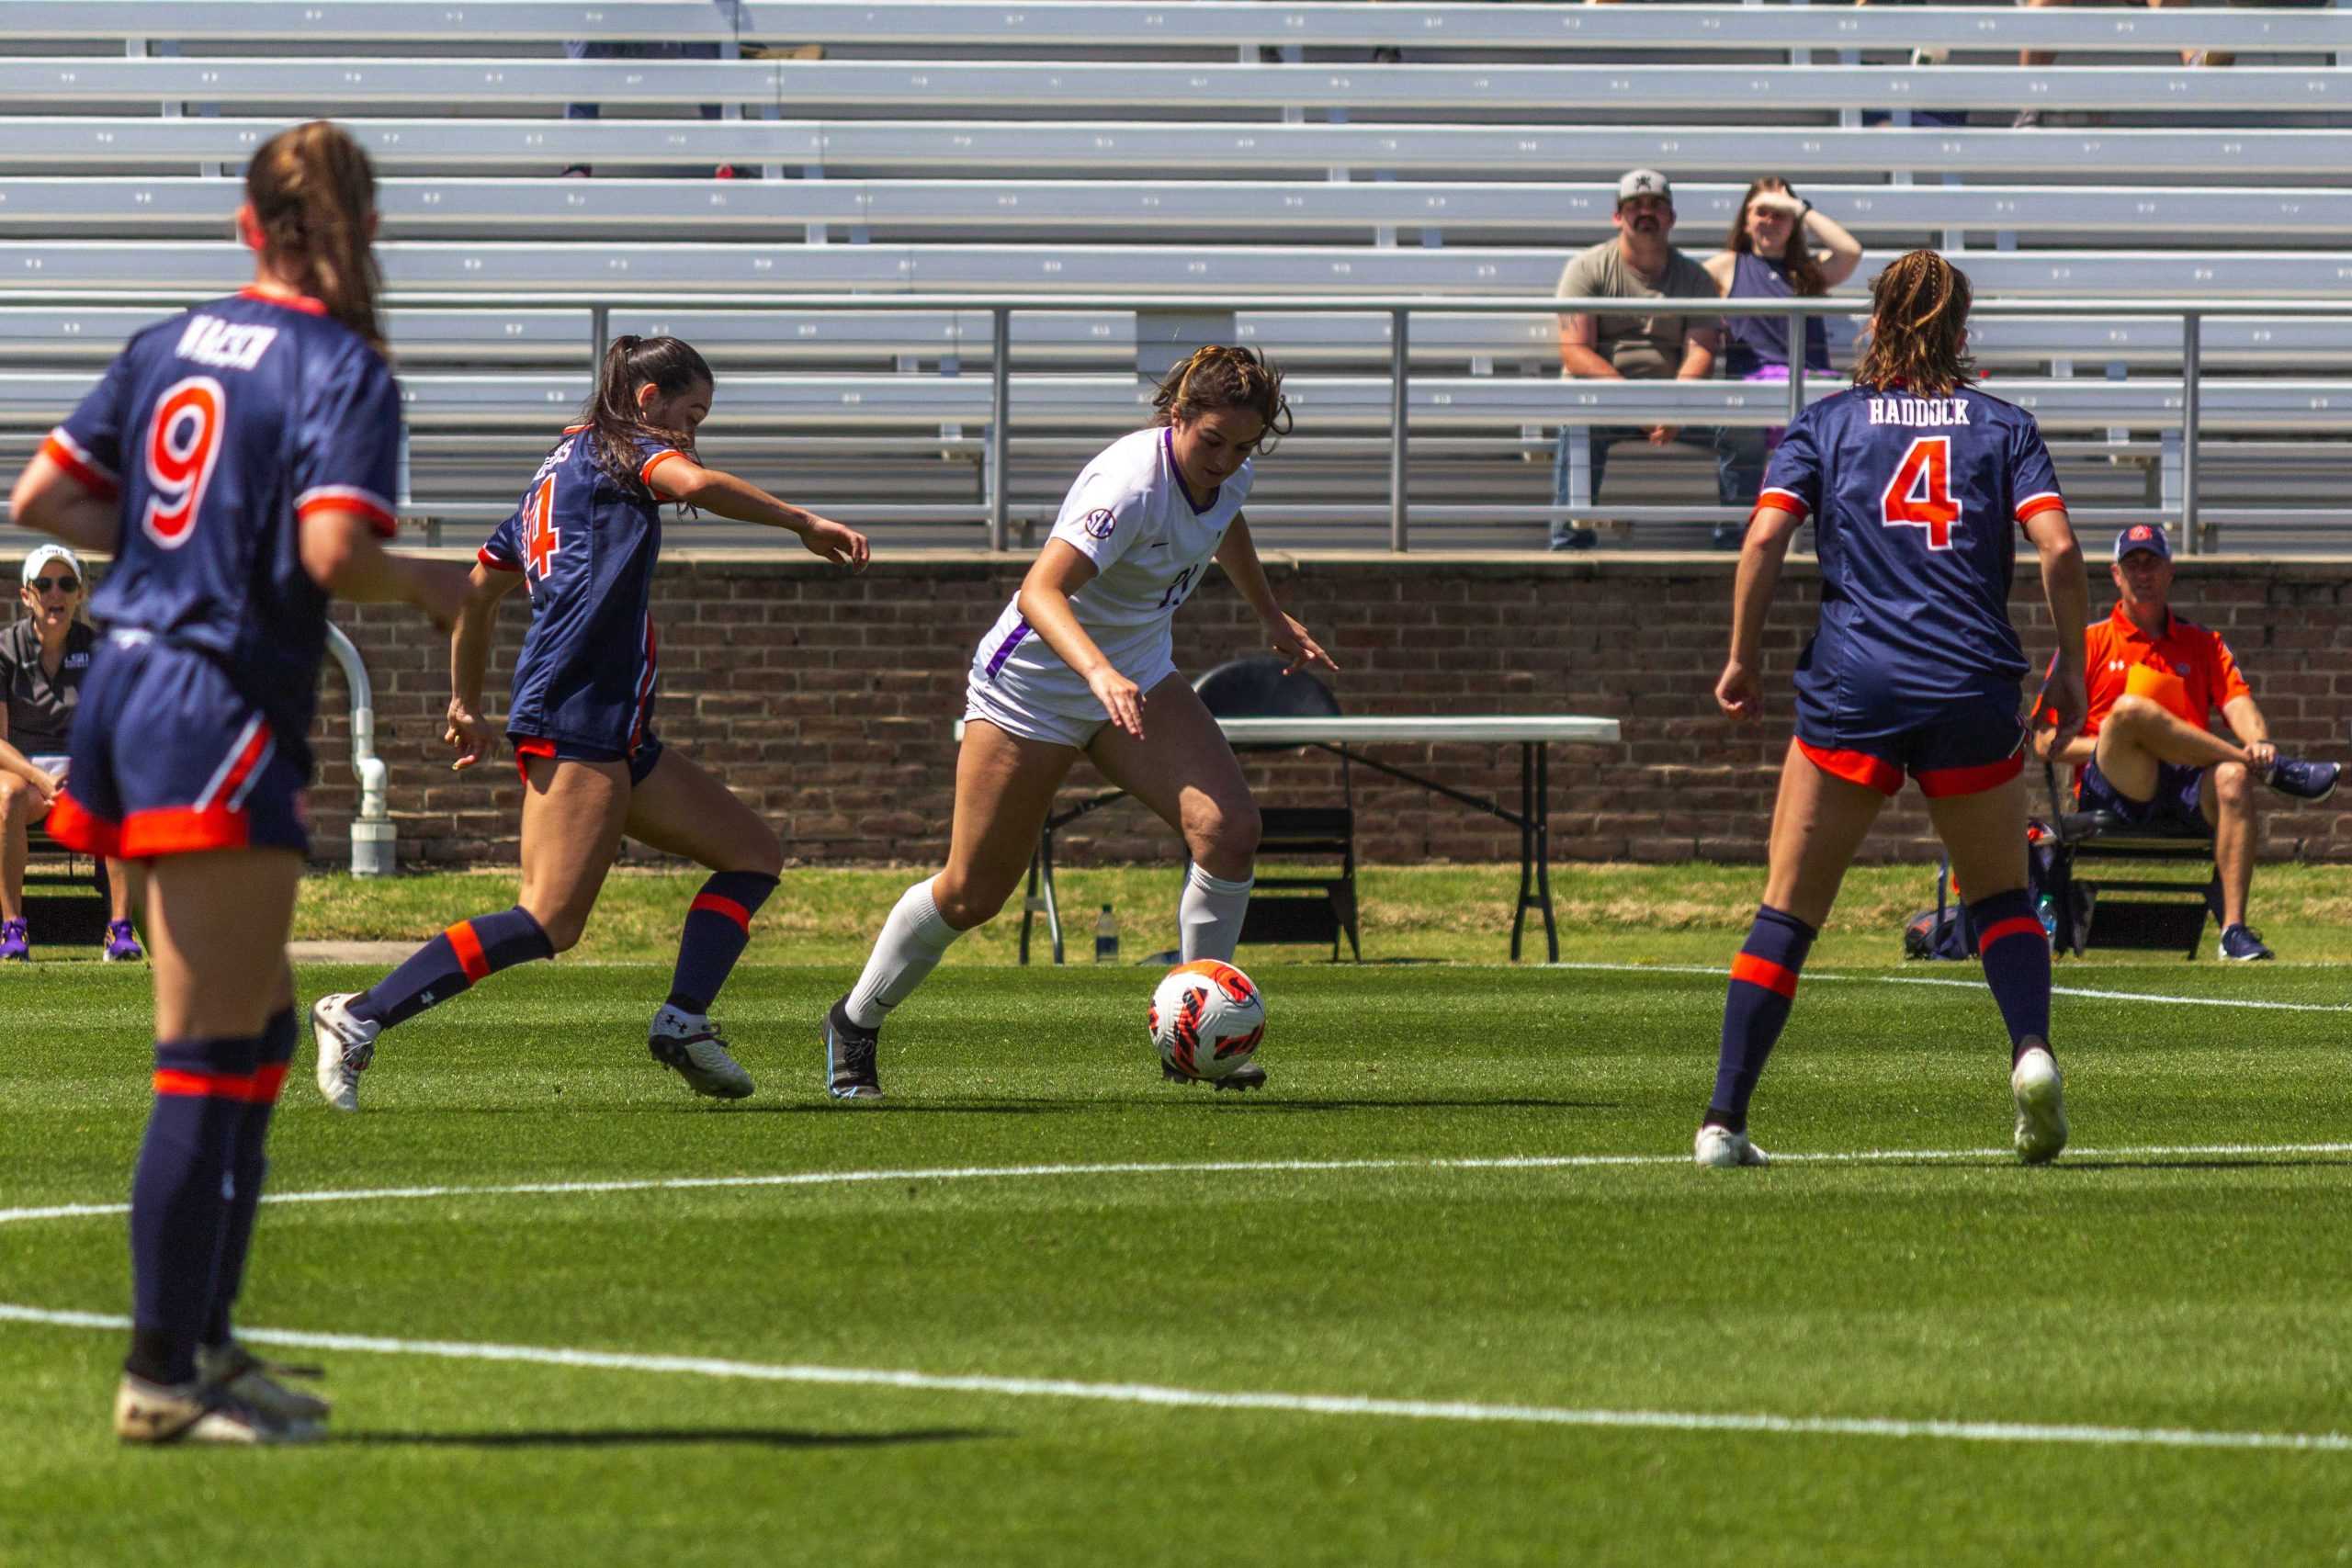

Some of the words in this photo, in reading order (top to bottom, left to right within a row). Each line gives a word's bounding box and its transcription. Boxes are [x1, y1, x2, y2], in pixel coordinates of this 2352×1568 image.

[142, 375, 226, 549] 9
[1869, 397, 1970, 427] HADDOCK
[1881, 434, 1962, 550] 4
